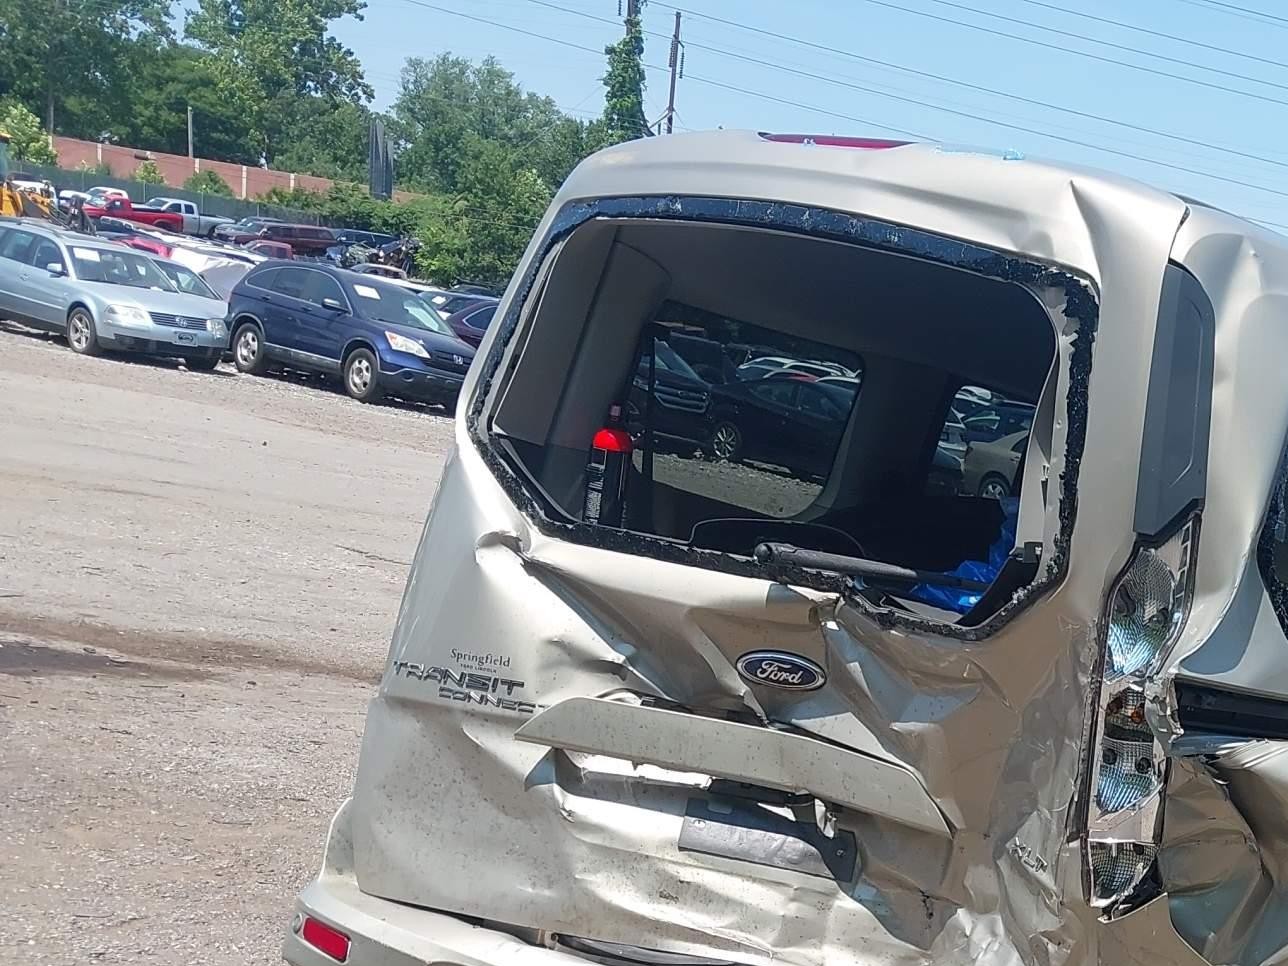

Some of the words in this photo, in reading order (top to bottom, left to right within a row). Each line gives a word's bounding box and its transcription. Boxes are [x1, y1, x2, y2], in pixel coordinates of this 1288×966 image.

[450, 648, 511, 668] Springfield
[393, 660, 525, 696] TRANSIT
[756, 660, 803, 684] Ford
